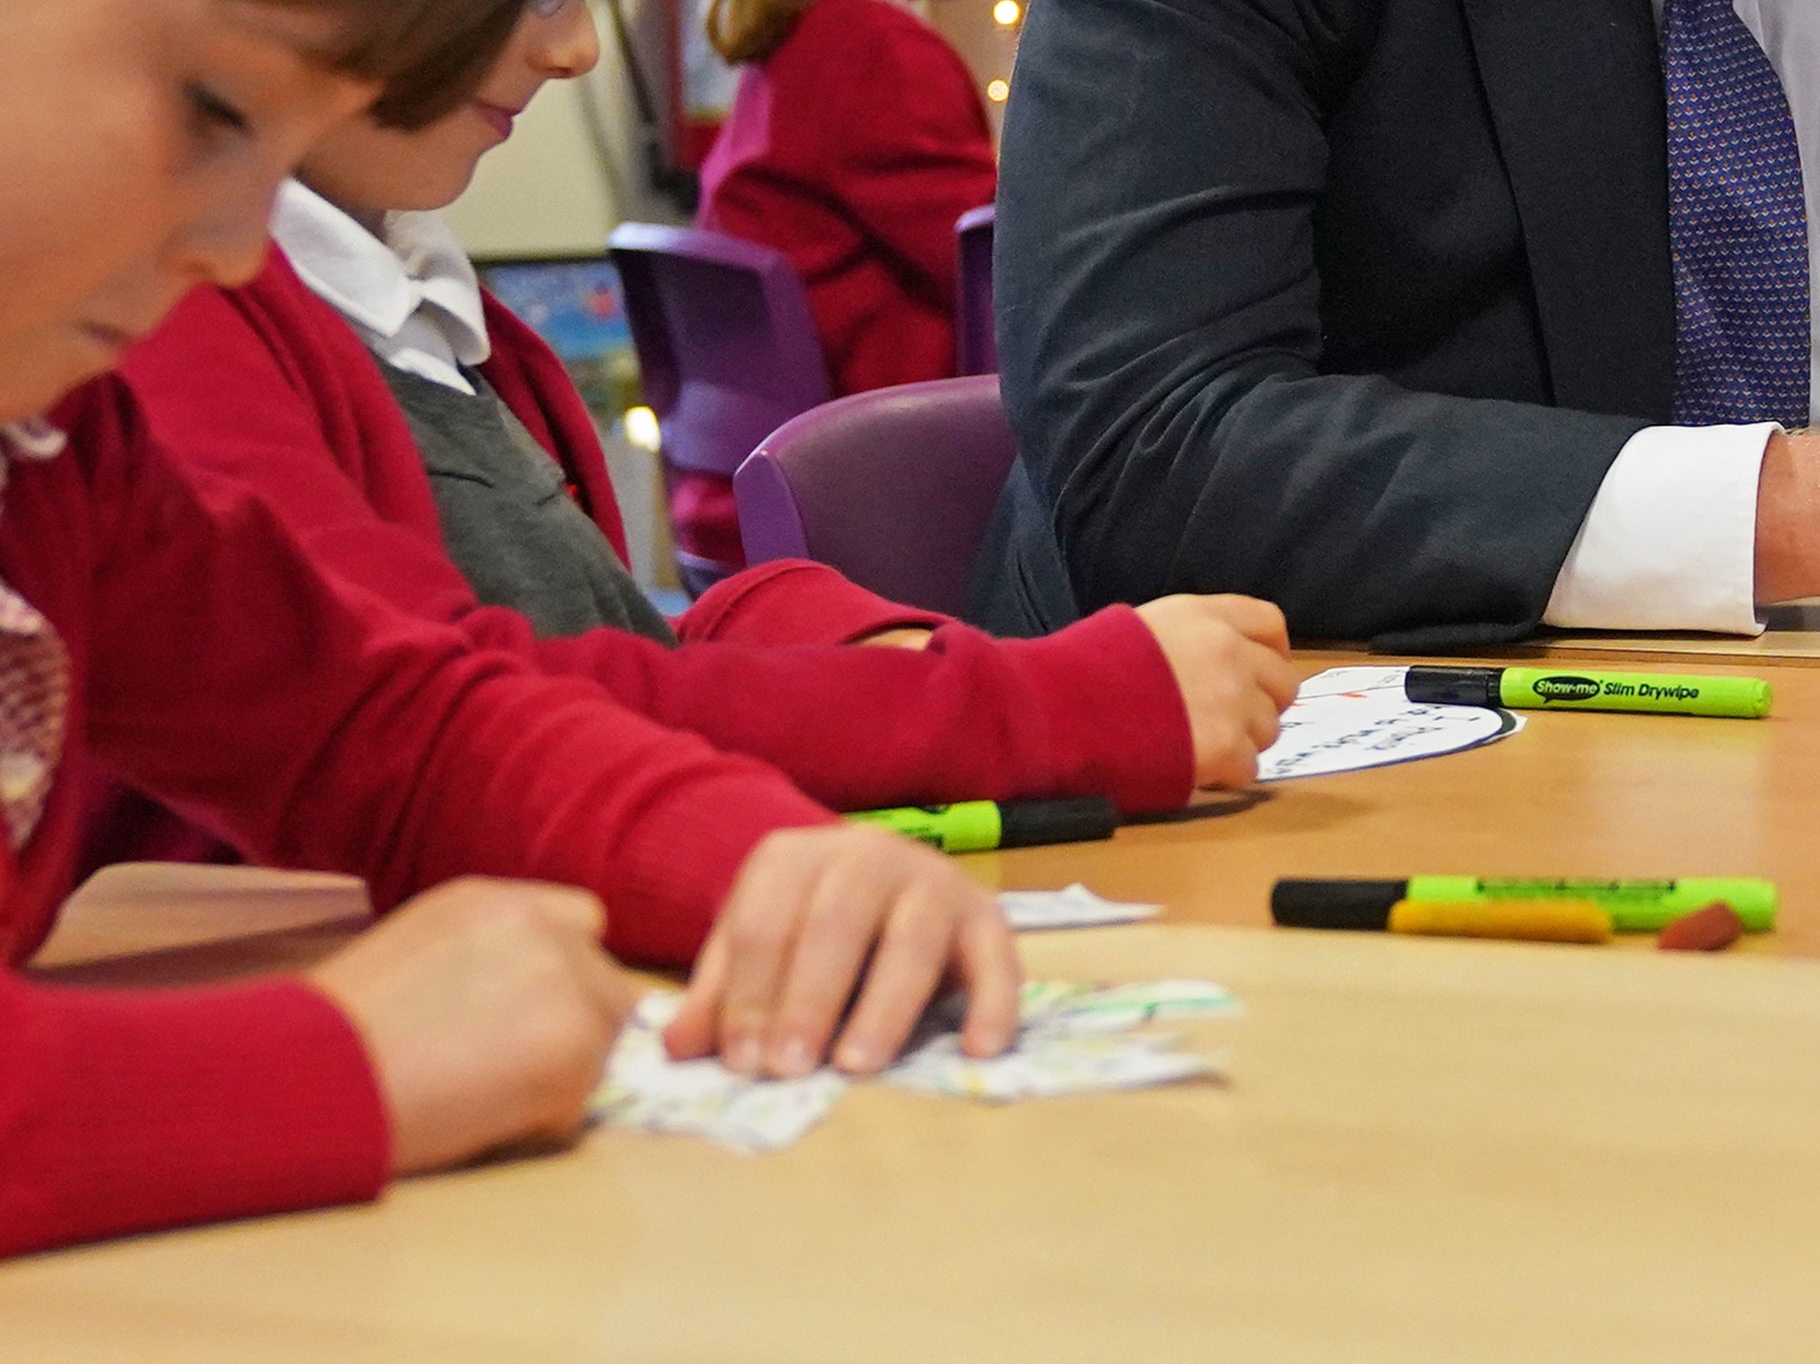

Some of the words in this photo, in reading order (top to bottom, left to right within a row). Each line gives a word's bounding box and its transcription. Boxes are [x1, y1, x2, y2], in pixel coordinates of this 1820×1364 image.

[1536, 679, 1598, 696] Show-me
[1603, 681, 1635, 697] Slim
[1638, 683, 1700, 701] Drywipe
